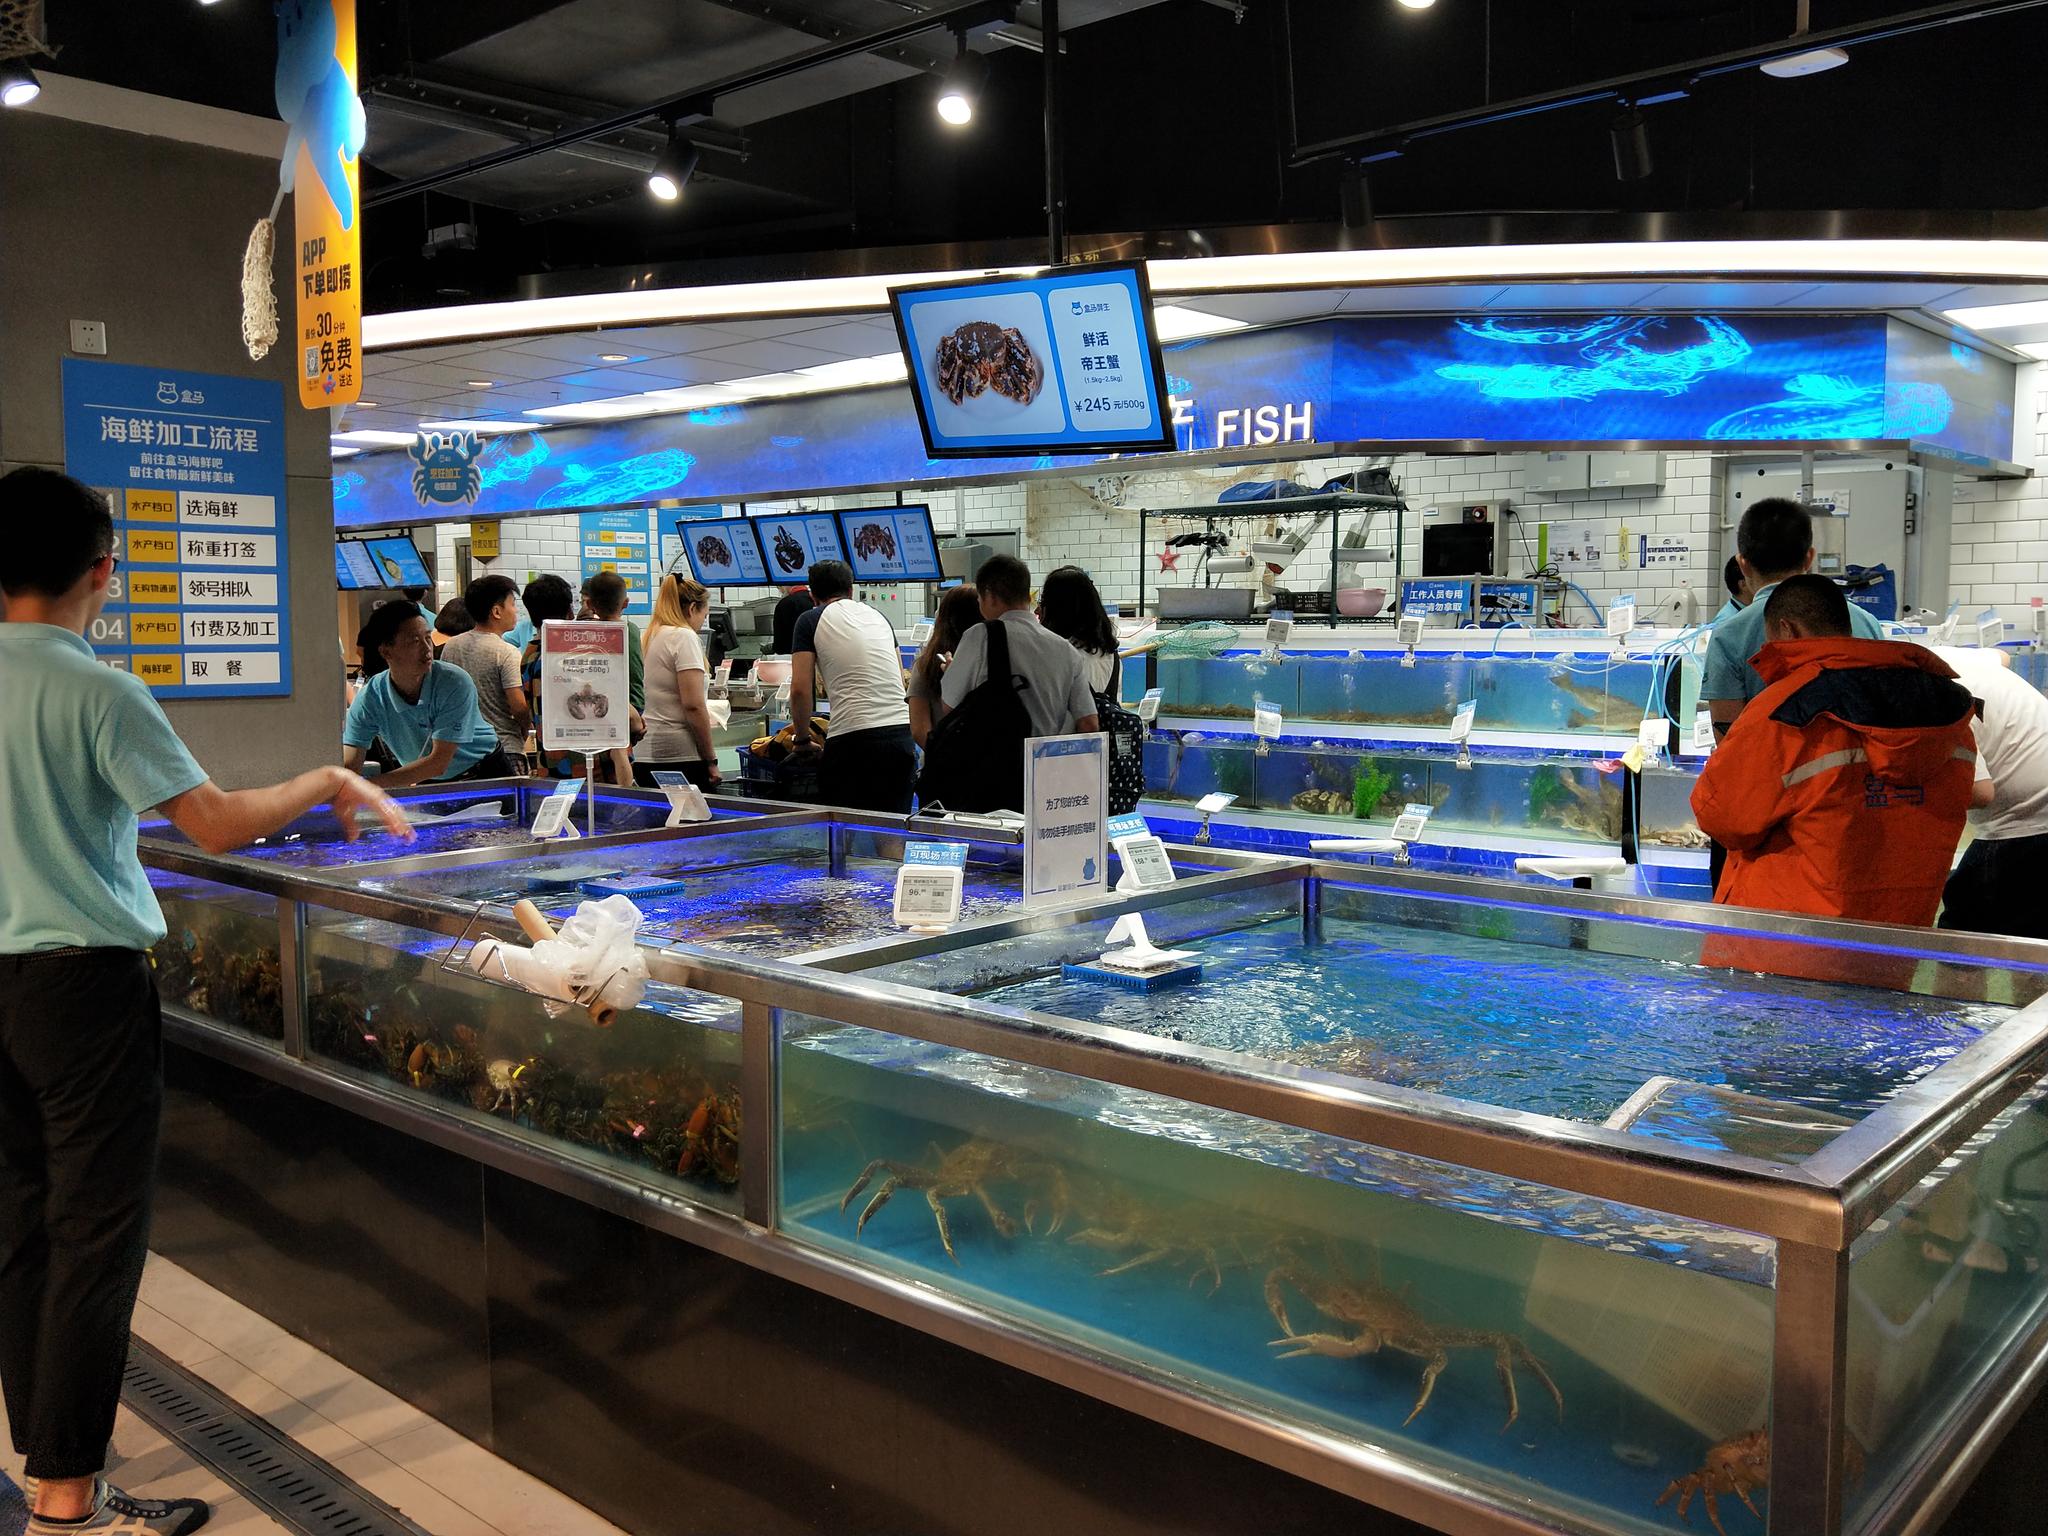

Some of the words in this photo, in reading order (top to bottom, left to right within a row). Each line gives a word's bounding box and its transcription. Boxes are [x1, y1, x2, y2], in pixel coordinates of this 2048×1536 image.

[303, 237, 327, 267] APP
[303, 263, 352, 299] 下单即捞
[1082, 331, 1110, 347] 鲜活
[320, 337, 352, 374] 免费
[1081, 355, 1120, 371] 帝王蟹
[339, 374, 353, 387] 送达
[1084, 375, 1123, 384] (1.5kg-2.5kg)
[181, 390, 205, 404] 盒马
[1114, 400, 1145, 410] 元/500g
[1217, 401, 1312, 448] FISH
[101, 415, 259, 453] 海鲜加工流程
[140, 452, 223, 469] 前往盒马海鲜吧
[129, 466, 236, 484] 留住食物最新鲜美味
[132, 501, 173, 513] 水产档口
[186, 499, 239, 518] 选海鲜
[132, 540, 174, 550] 水产档口
[187, 540, 257, 558] 称重打签
[132, 584, 177, 594] 无购物通道
[189, 580, 253, 598] 领号排队
[1410, 589, 1463, 599] 工作人员专用
[91, 619, 124, 640] 04
[135, 622, 177, 633] 水产档口
[190, 620, 276, 637] 付费及加工
[141, 664, 173, 675] 海鲜吧
[1046, 794, 1090, 811] 为了您的安全
[910, 850, 960, 860] 可现场烹饪
